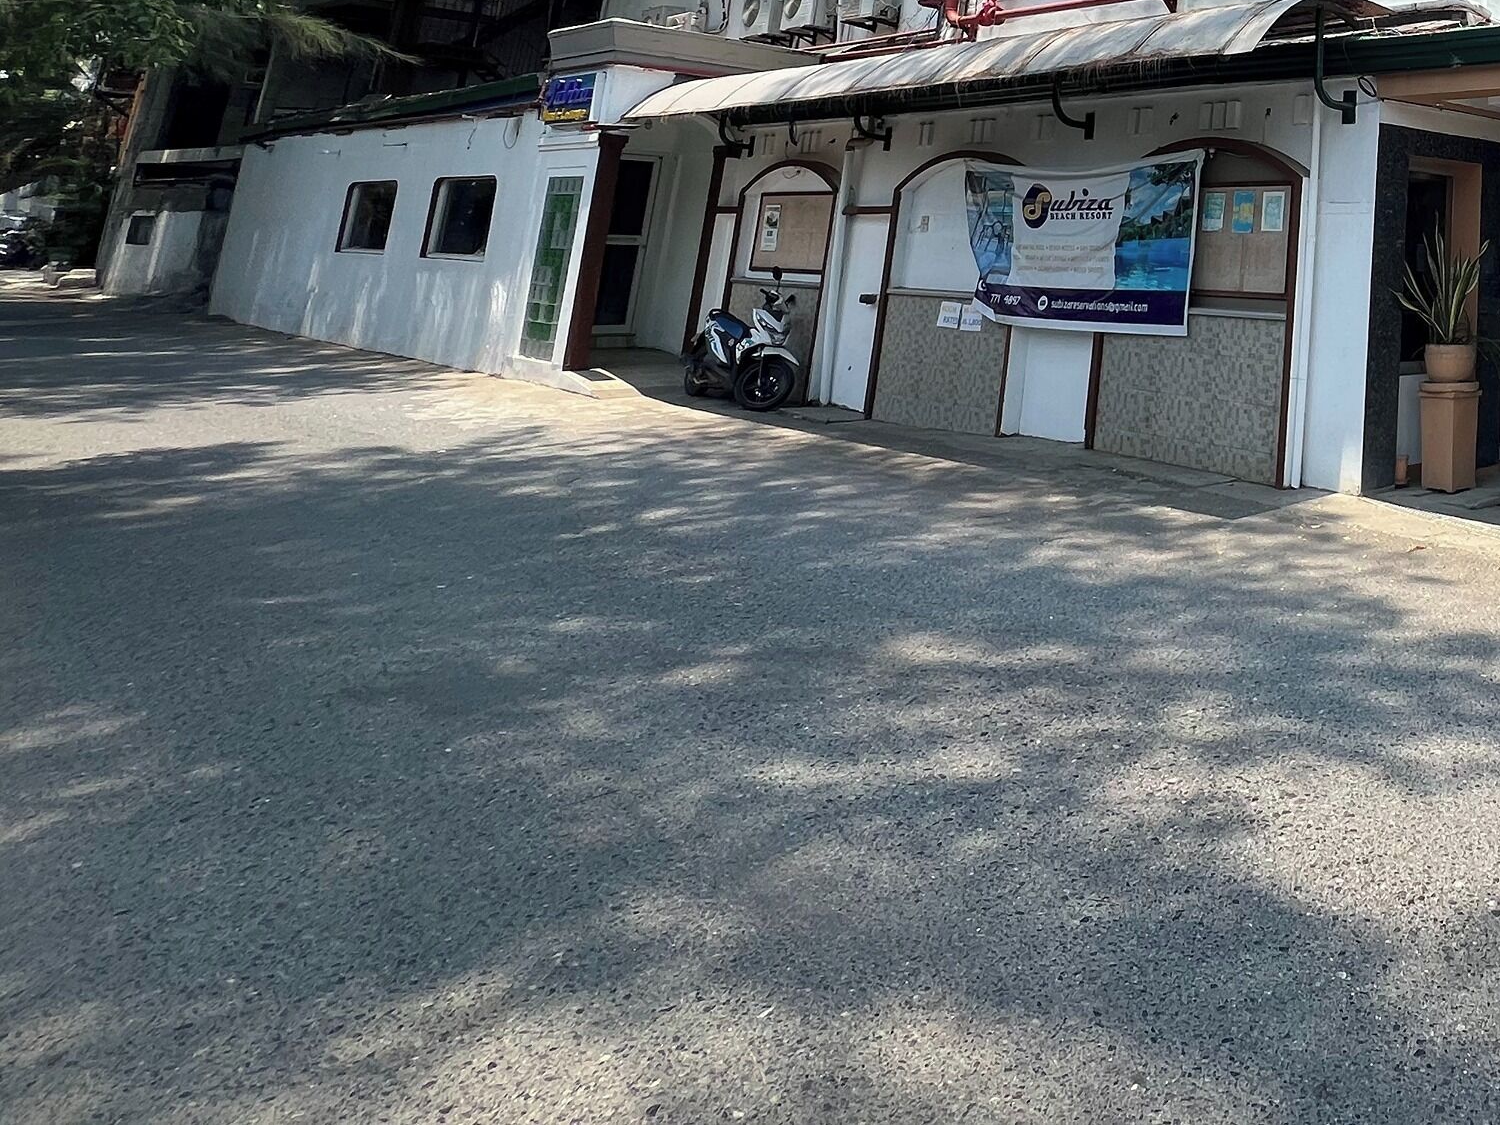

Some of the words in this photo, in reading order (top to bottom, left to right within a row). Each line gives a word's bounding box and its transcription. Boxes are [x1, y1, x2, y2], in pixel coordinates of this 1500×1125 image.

[1023, 187, 1114, 221] Subiza
[1049, 212, 1076, 221] BEACH
[1079, 211, 1113, 220] RESORT
[1050, 299, 1148, 313] subizareservations@gmail.com
